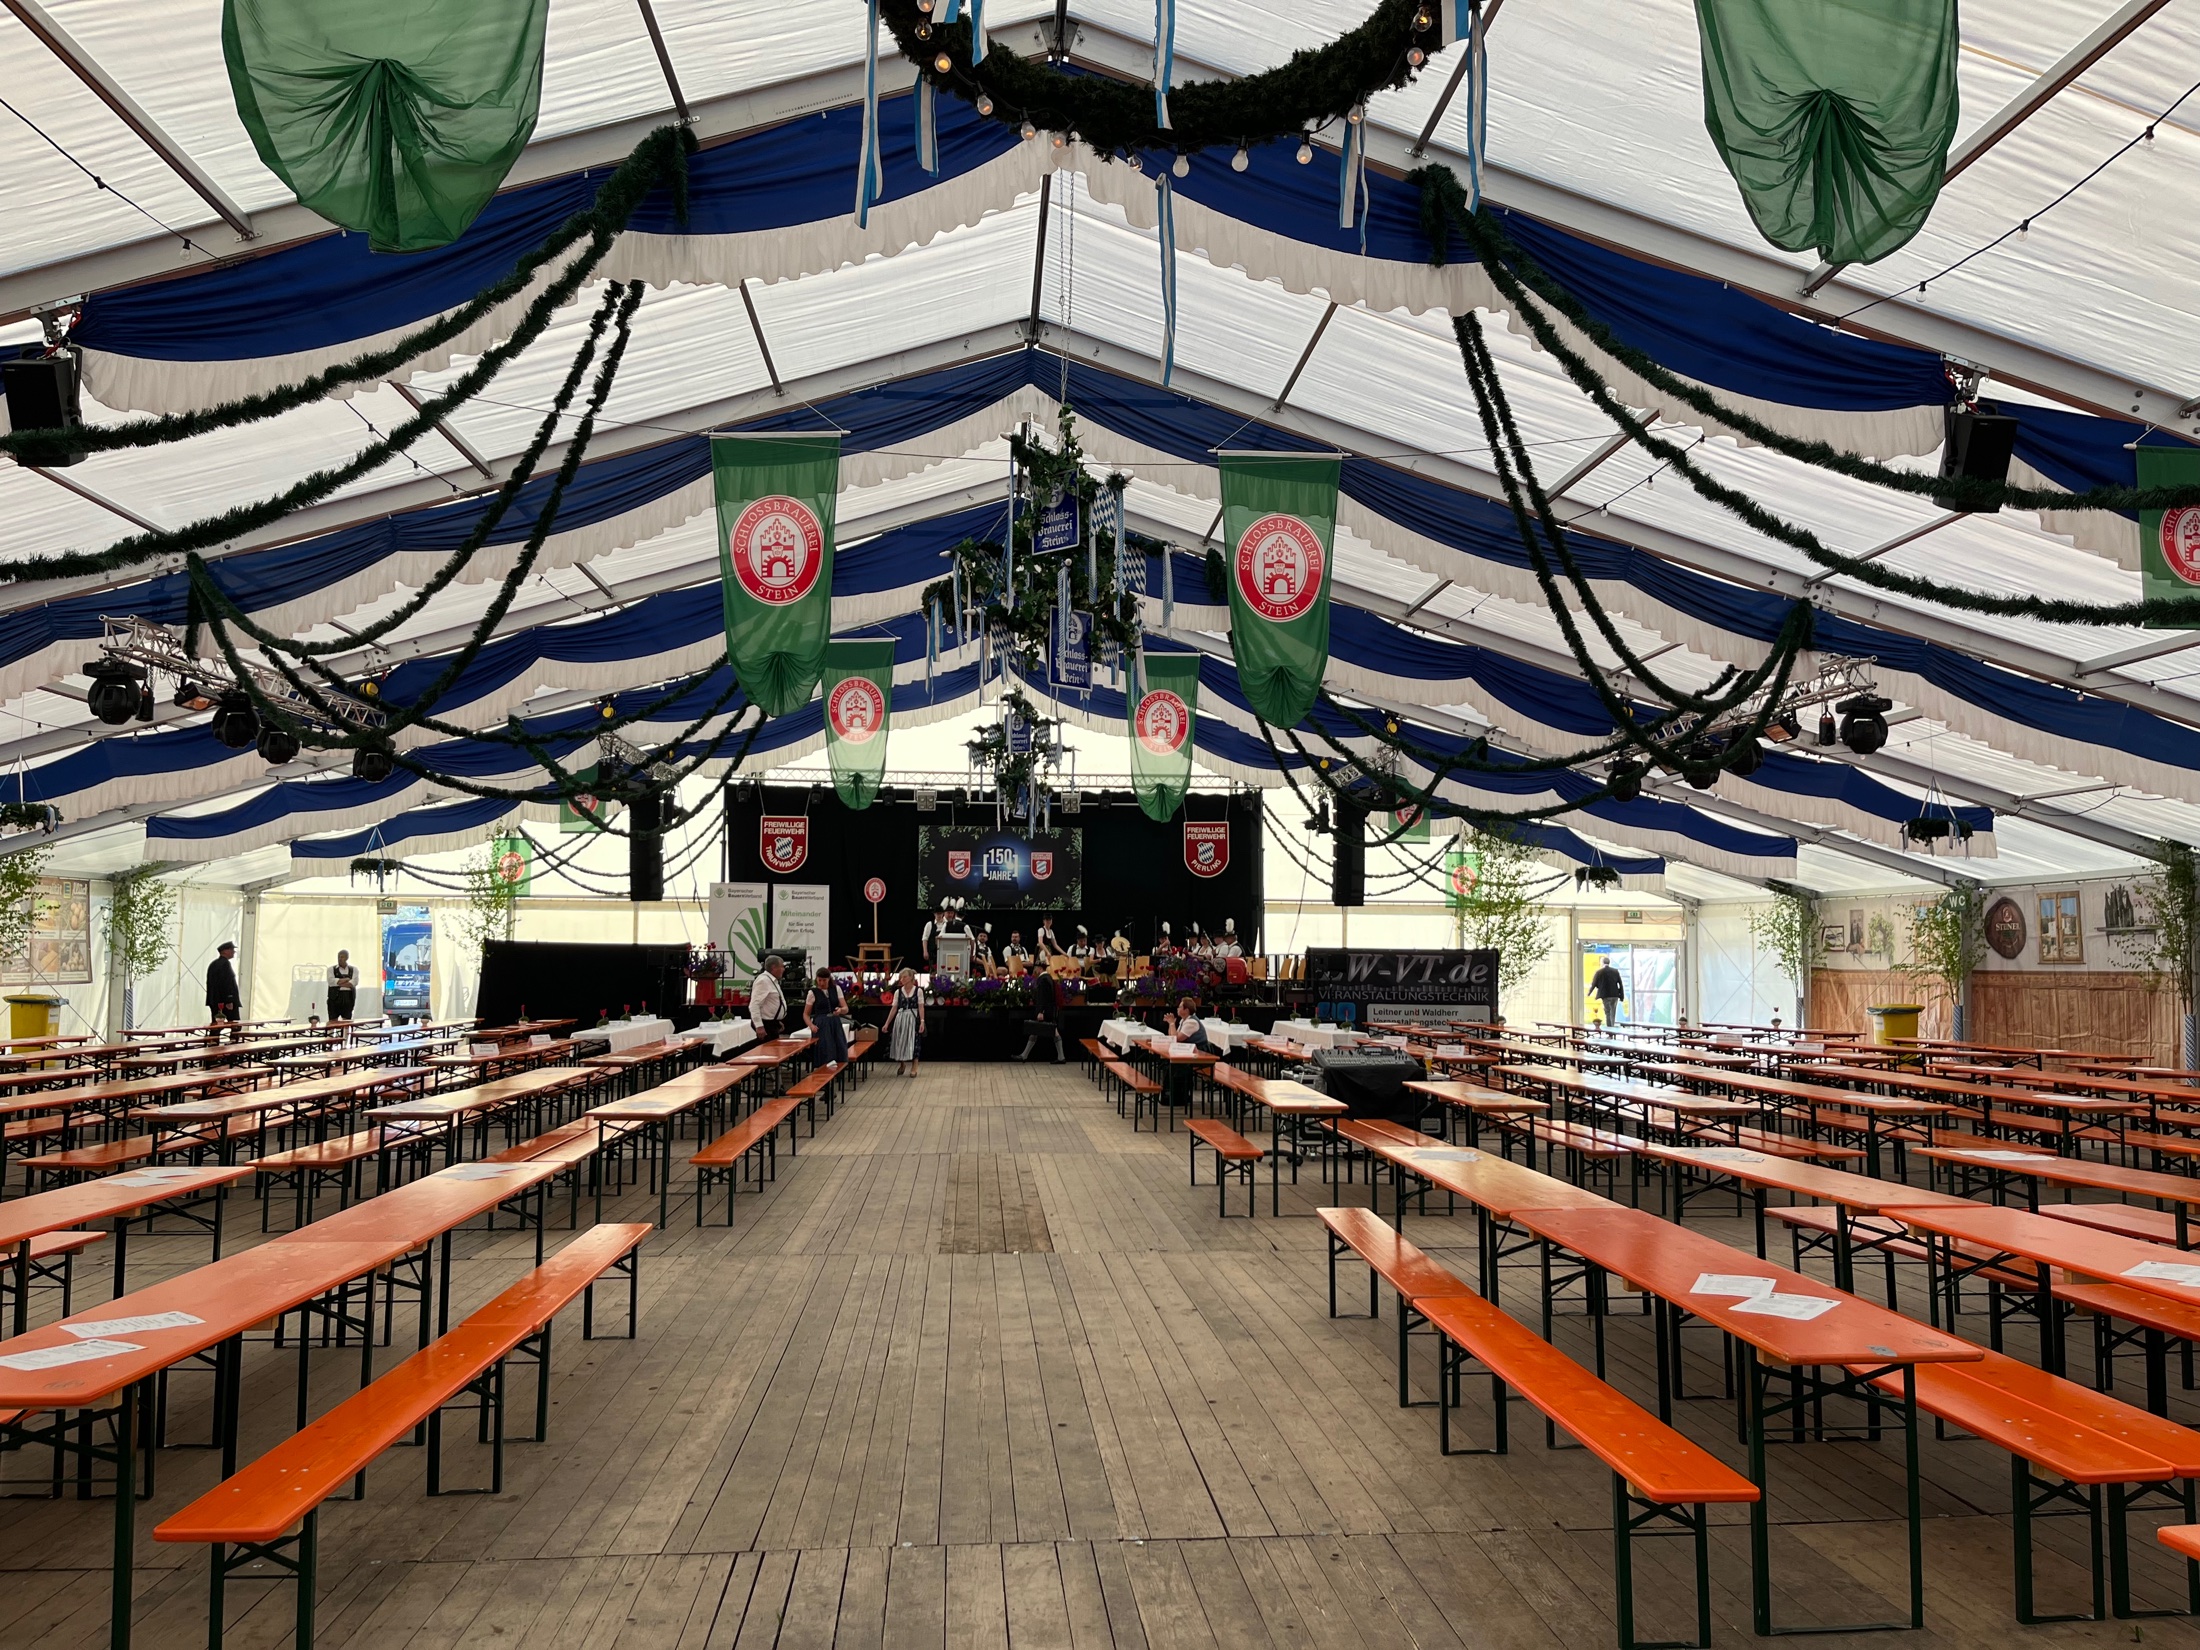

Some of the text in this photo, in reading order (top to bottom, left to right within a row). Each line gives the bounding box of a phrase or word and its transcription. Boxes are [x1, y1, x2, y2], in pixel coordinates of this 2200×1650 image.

[735, 501, 819, 554] SCHLOSSBRAUEREI
[1240, 519, 1320, 571] SCHLOSSBRAUEREI
[2182, 567, 2200, 580] STE
[756, 585, 799, 600] STEIN
[1258, 601, 1299, 616] STEIN
[831, 680, 882, 714] SCHLOSSBRAUEREI
[1137, 692, 1186, 725] SCHLOSSBRAUEREI
[845, 732, 870, 741] STEIN
[1148, 744, 1174, 753] STEIN
[765, 845, 804, 868] TRAUNWALCHEN
[988, 848, 1012, 864] 150
[1191, 859, 1222, 872] PIERLING
[988, 870, 1012, 880] JAHRE
[1948, 895, 1966, 908] WC
[1318, 990, 1489, 1002] VERANSTALTUNGSTECHNIK
[1373, 1008, 1402, 1016] Leitner
